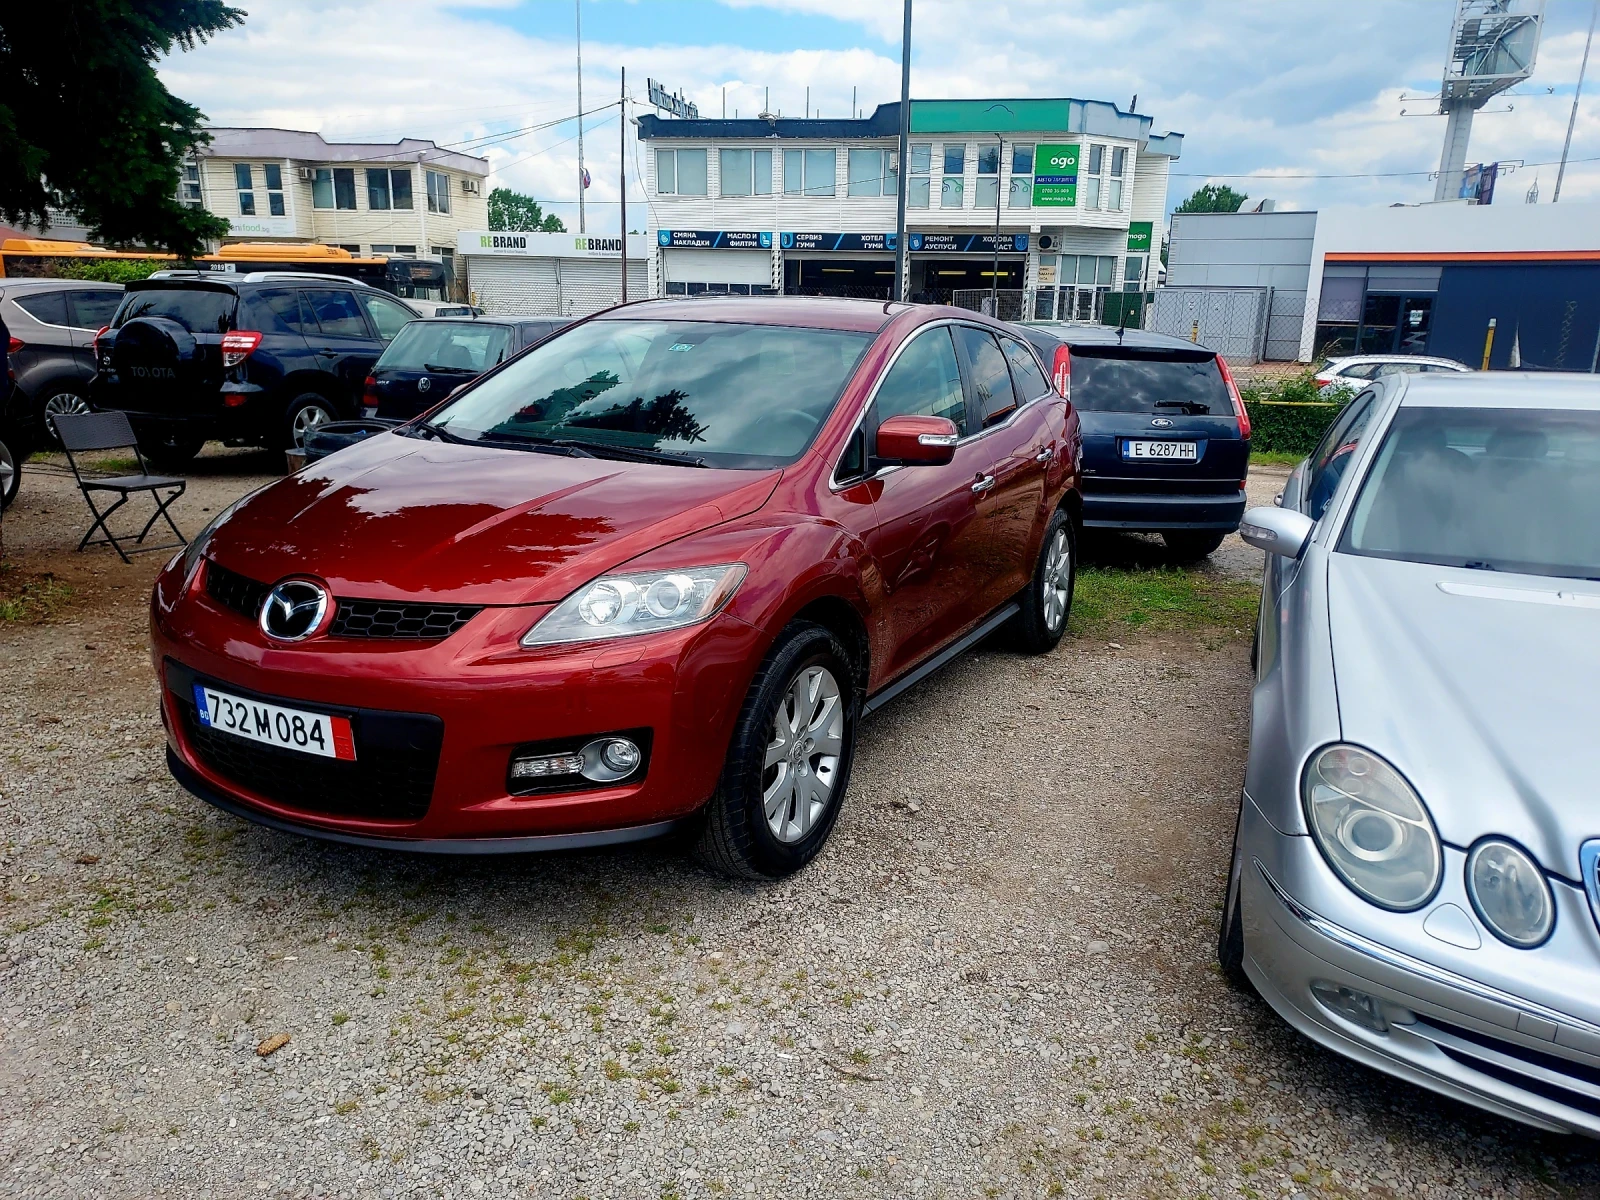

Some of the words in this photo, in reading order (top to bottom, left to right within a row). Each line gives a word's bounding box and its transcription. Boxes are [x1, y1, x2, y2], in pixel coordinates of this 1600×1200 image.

[480, 236, 527, 249] REBRAND
[575, 238, 622, 251] REBRAND
[1149, 443, 1177, 457] 6287
